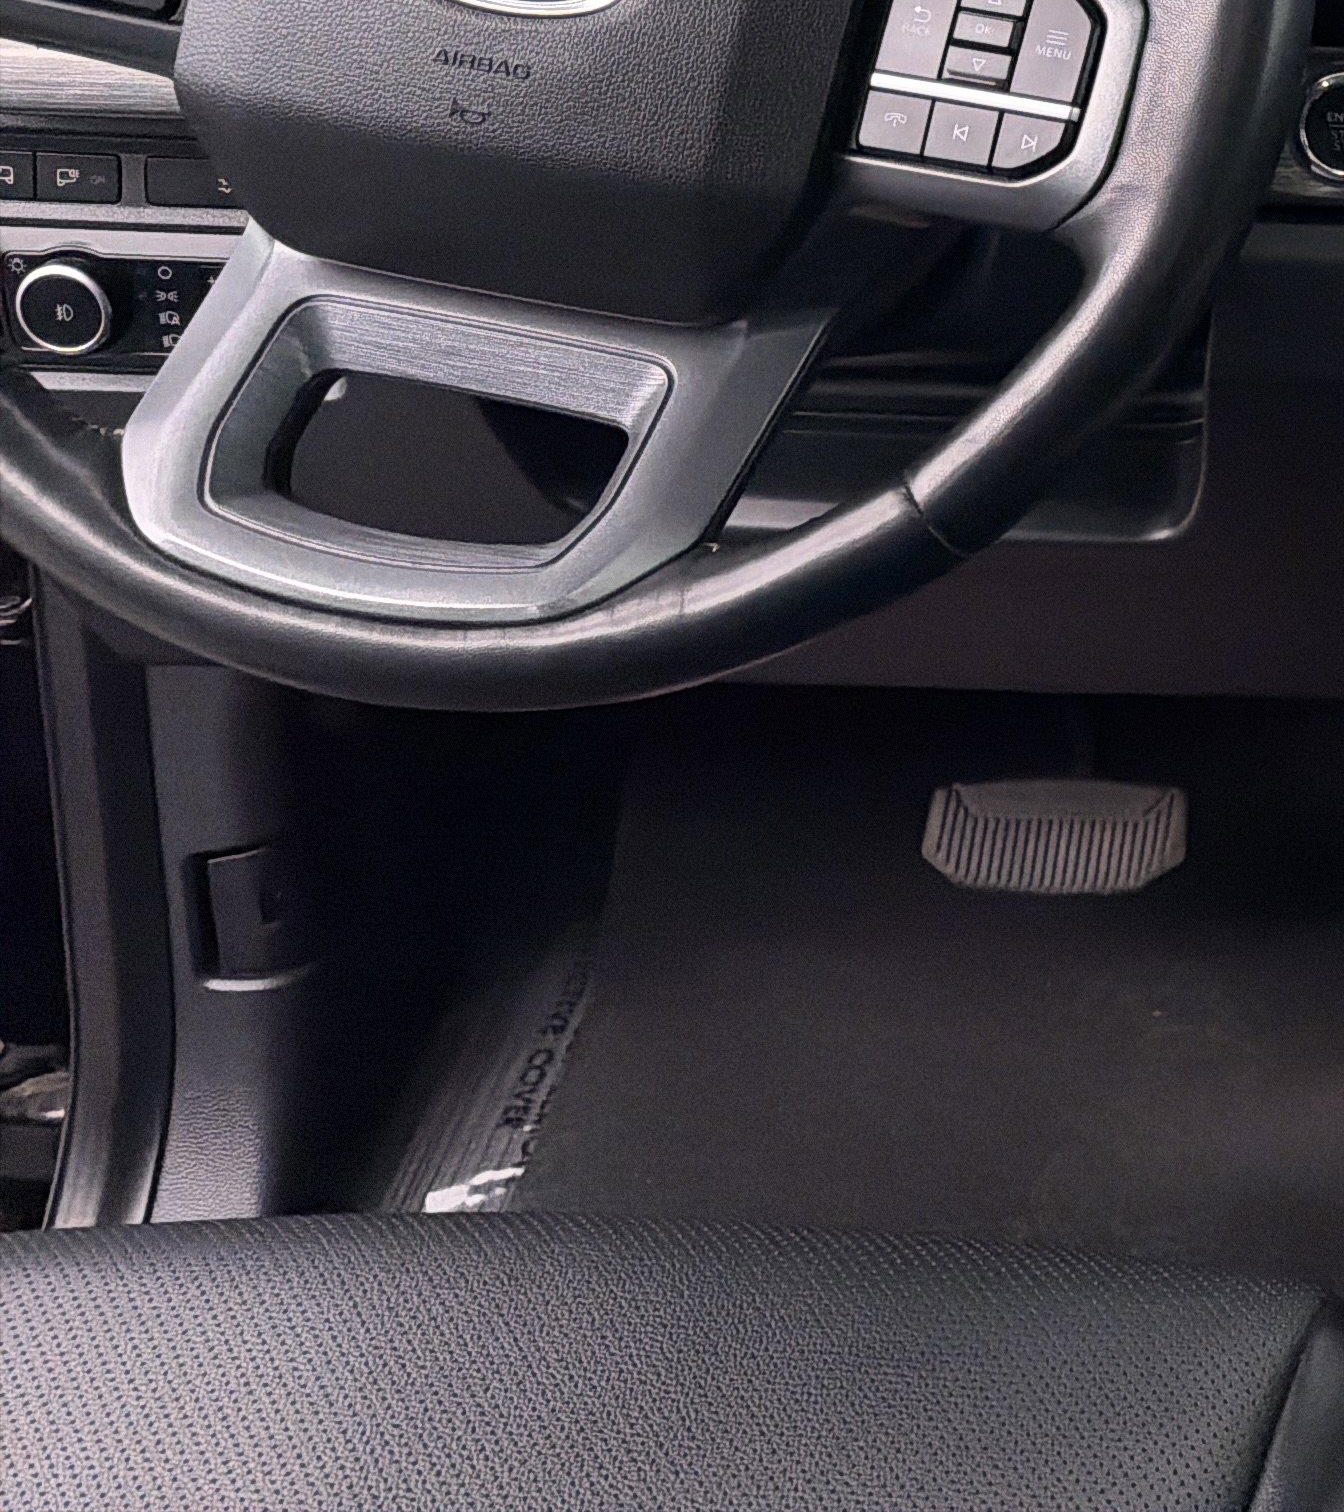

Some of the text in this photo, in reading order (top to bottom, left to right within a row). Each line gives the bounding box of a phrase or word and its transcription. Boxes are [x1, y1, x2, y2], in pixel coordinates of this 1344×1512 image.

[974, 23, 993, 35] OK
[1035, 45, 1072, 61] MENU
[432, 48, 531, 80] AIRBAG
